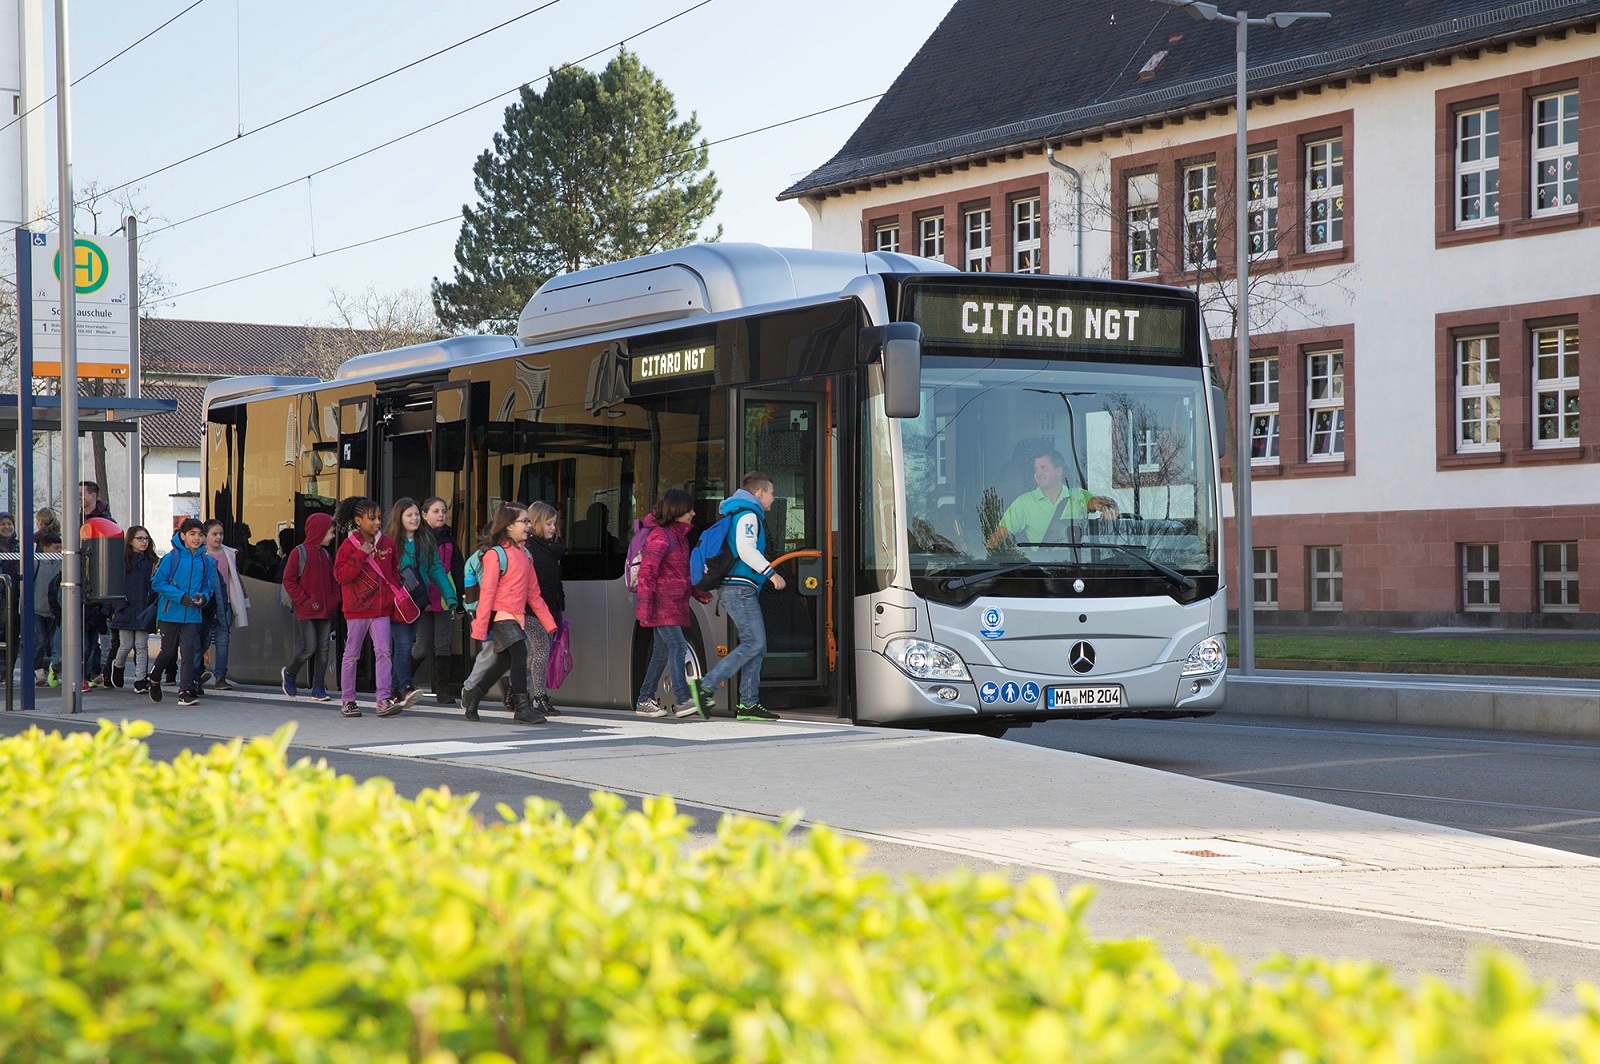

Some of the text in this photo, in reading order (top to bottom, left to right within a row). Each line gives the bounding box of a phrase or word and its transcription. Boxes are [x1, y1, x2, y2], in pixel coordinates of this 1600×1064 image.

[51, 307, 113, 318] Scauschule
[42, 323, 46, 332] 1
[962, 301, 1140, 341] CITARO NGT
[641, 348, 706, 378] CITARO NGT
[745, 524, 754, 535] K
[1056, 689, 1119, 704] MA MB 204
